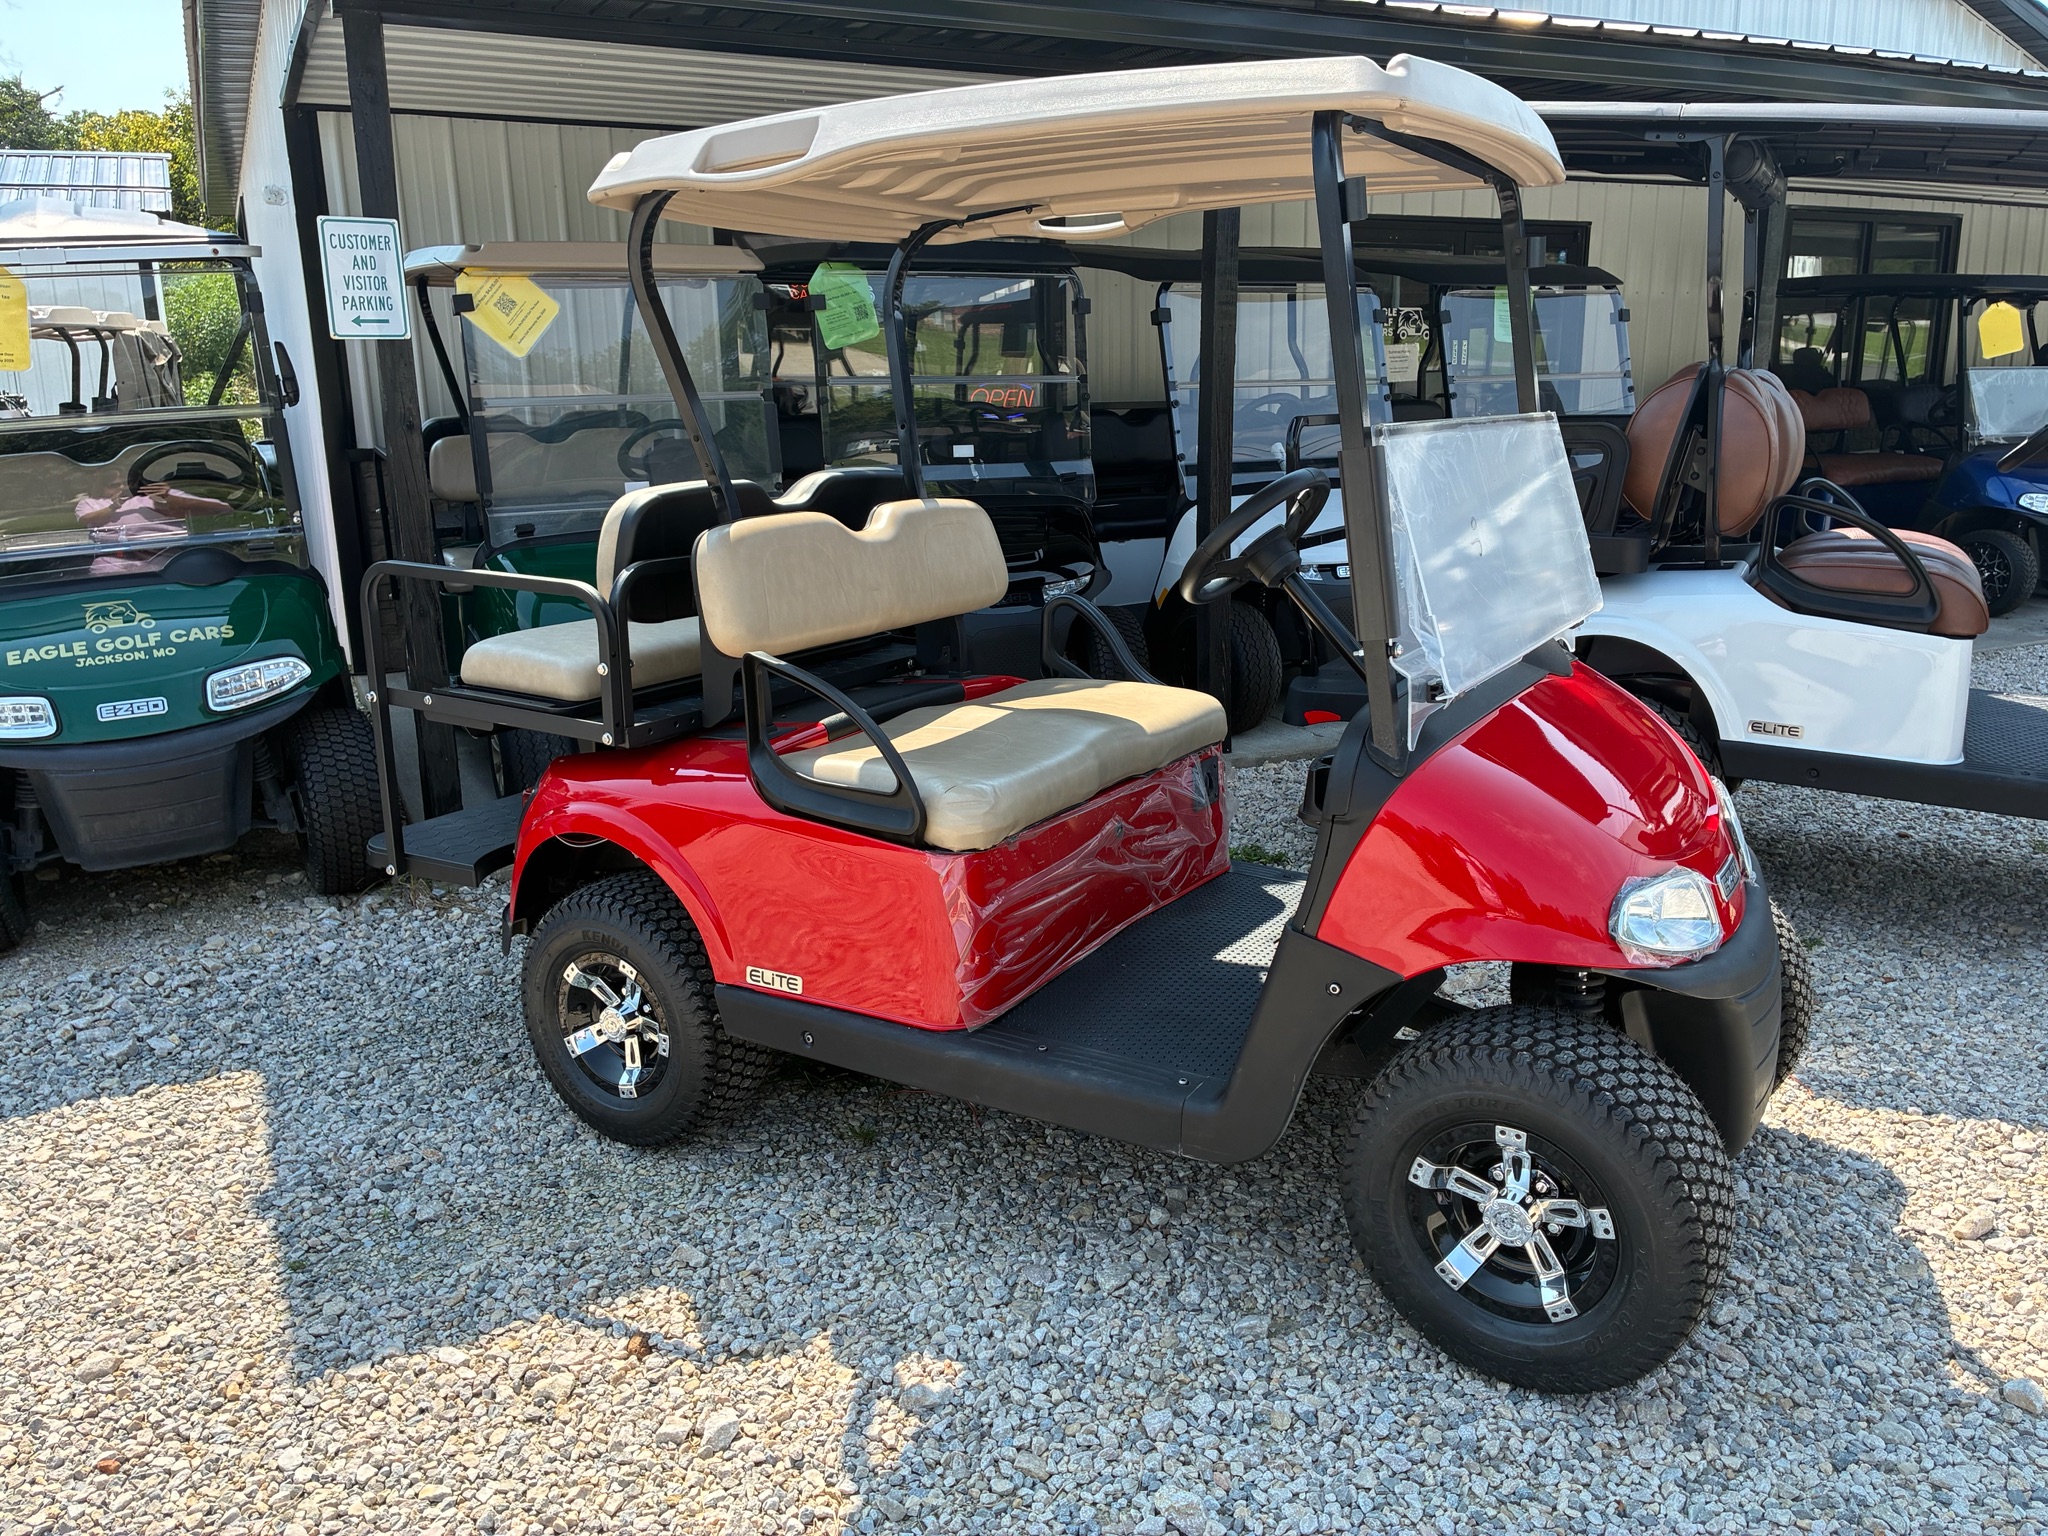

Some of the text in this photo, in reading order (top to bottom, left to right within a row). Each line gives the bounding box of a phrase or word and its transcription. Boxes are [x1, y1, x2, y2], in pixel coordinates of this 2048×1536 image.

[329, 233, 391, 251] CUSTOMER
[352, 255, 377, 271] AND
[343, 275, 388, 291] VISITOR
[342, 295, 394, 312] PARKING
[970, 388, 1035, 408] OPEN
[6, 624, 235, 666] EAGLE GOLF CARS
[75, 647, 177, 668] JACKSON, MO
[100, 700, 164, 718] EZGO
[581, 929, 630, 956] KENDA
